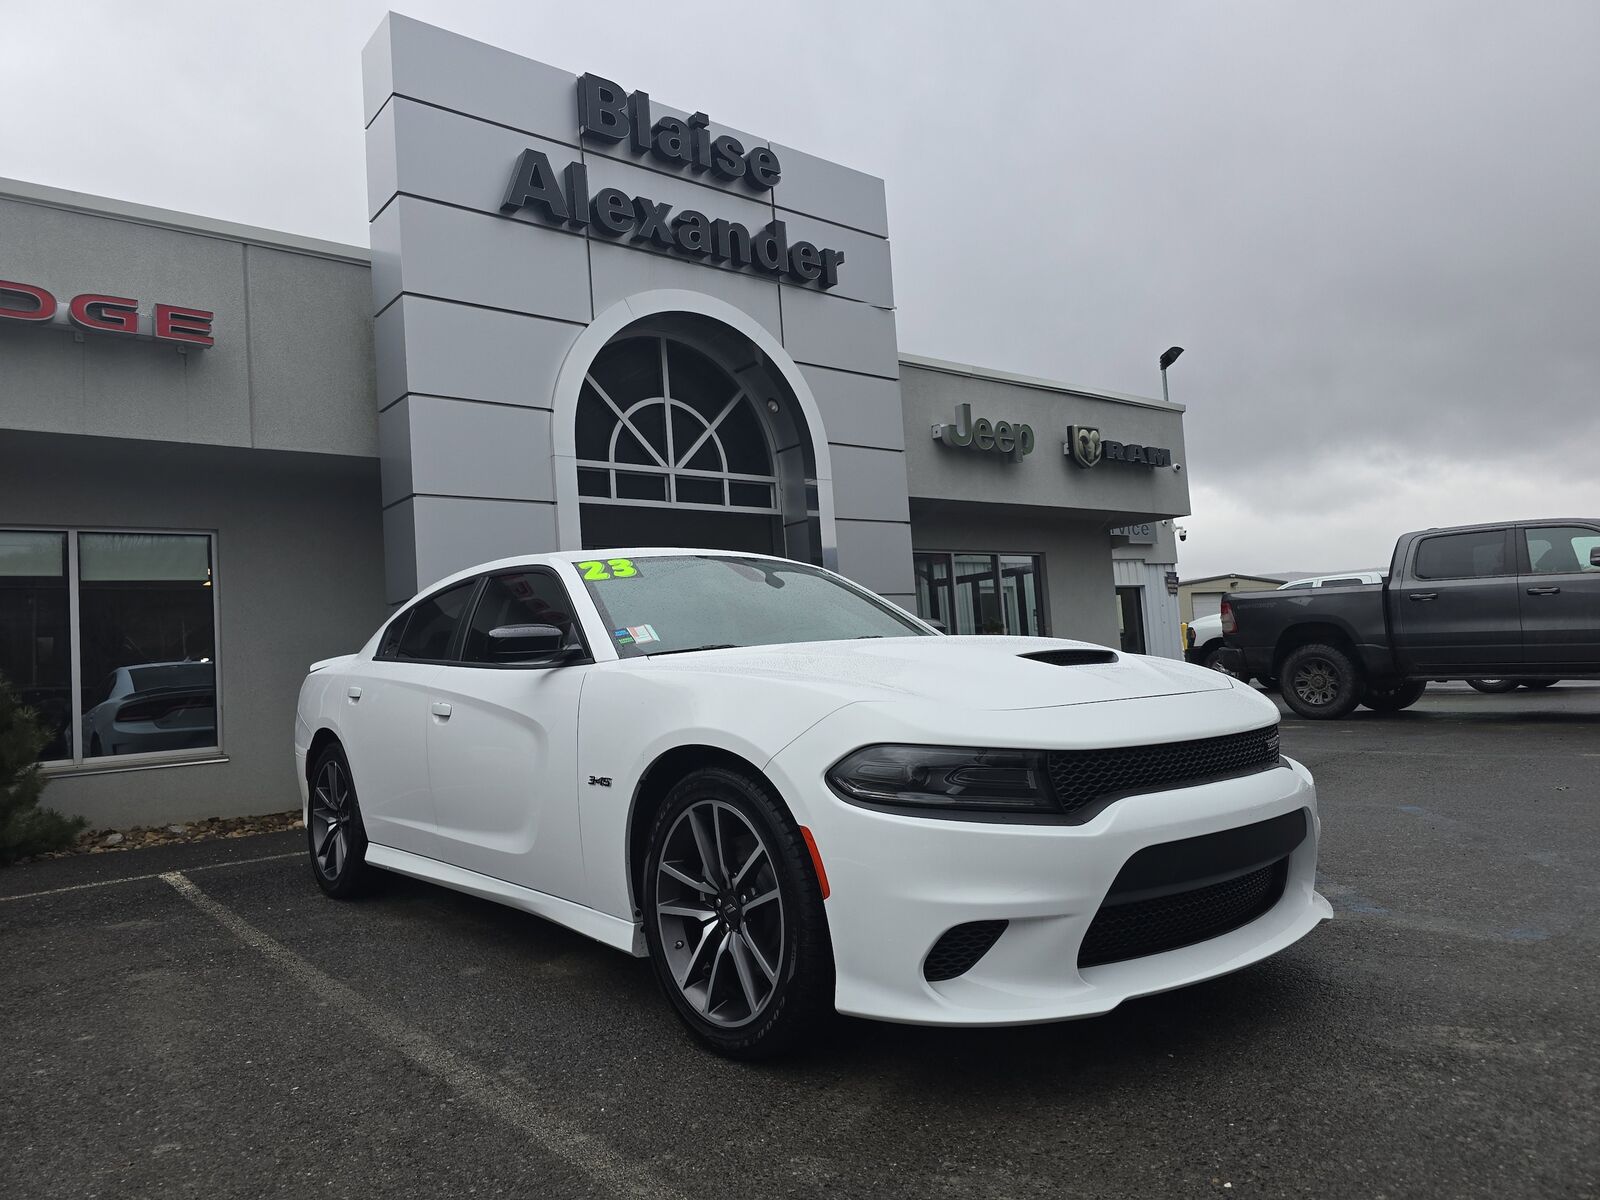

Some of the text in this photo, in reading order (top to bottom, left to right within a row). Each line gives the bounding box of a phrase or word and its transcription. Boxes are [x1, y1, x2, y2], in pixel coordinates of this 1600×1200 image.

[577, 72, 782, 191] Blaise
[500, 148, 845, 289] Alexander
[943, 403, 1035, 463] Jeep
[1101, 439, 1171, 467] RAM
[578, 558, 637, 581] 23
[588, 775, 613, 787] 345
